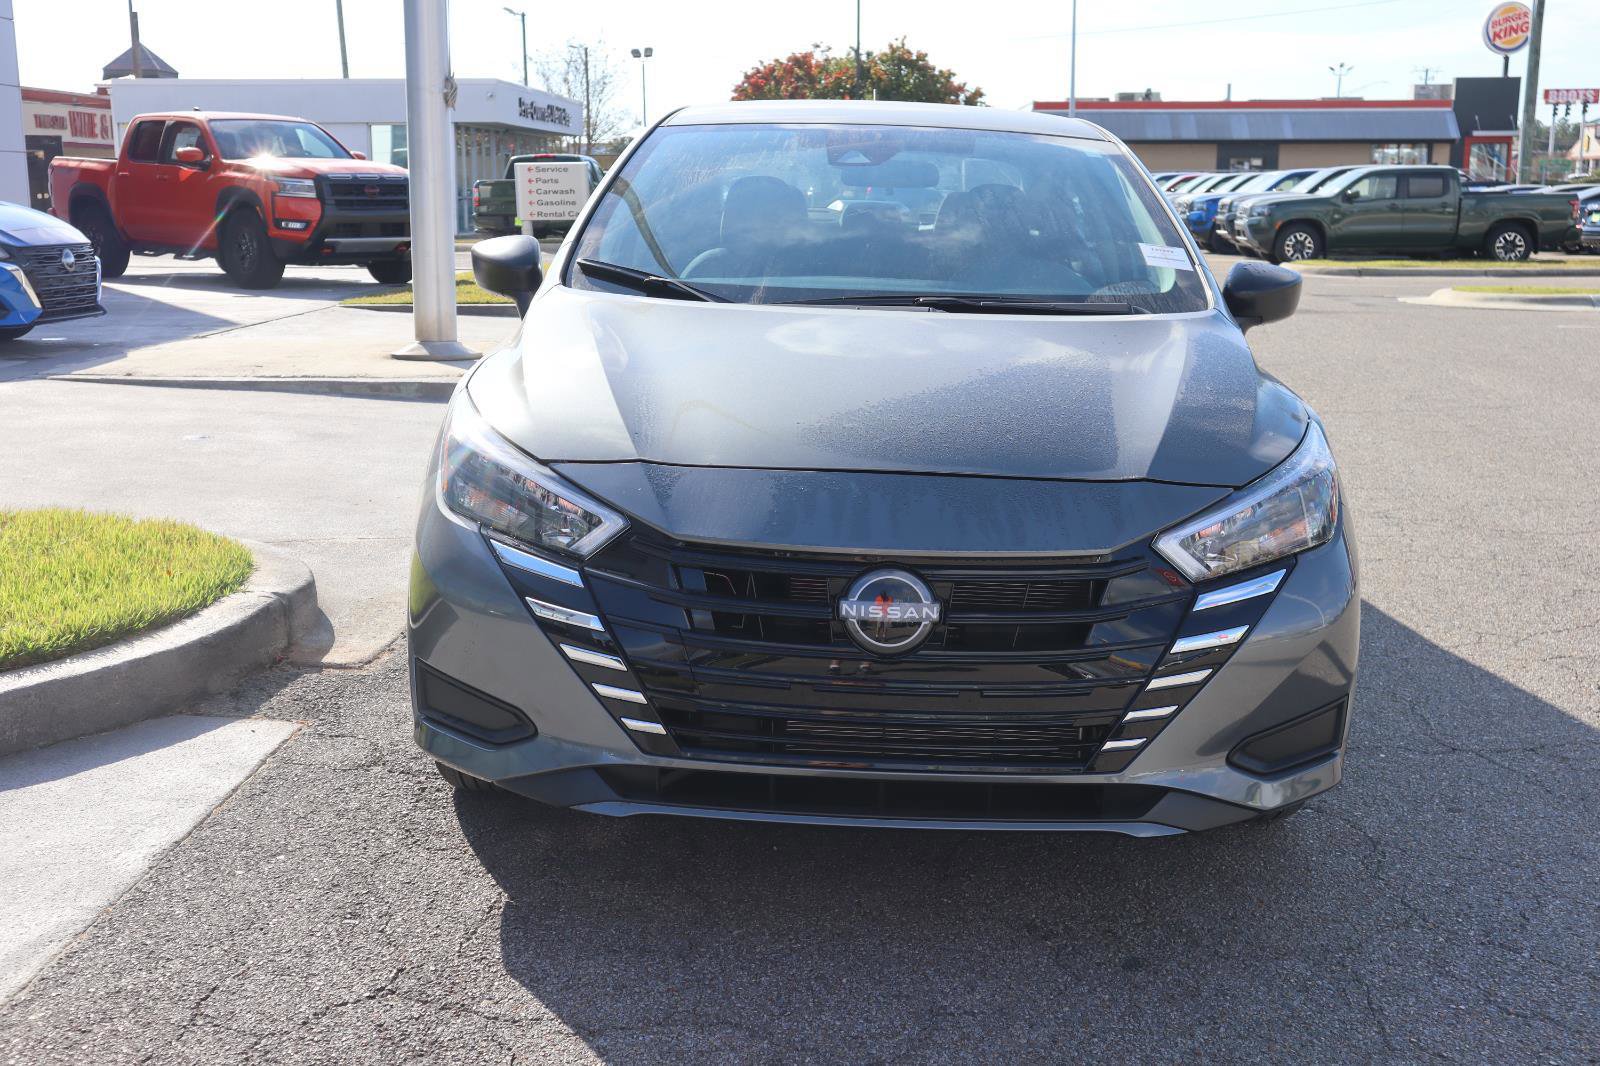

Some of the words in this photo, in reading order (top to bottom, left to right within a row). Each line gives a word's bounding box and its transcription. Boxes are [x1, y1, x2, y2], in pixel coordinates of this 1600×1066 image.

[1491, 11, 1529, 29] BURGER
[1492, 21, 1530, 42] KING
[68, 110, 98, 139] WINE
[537, 210, 565, 218] Rental
[841, 603, 937, 619] NISSAN
